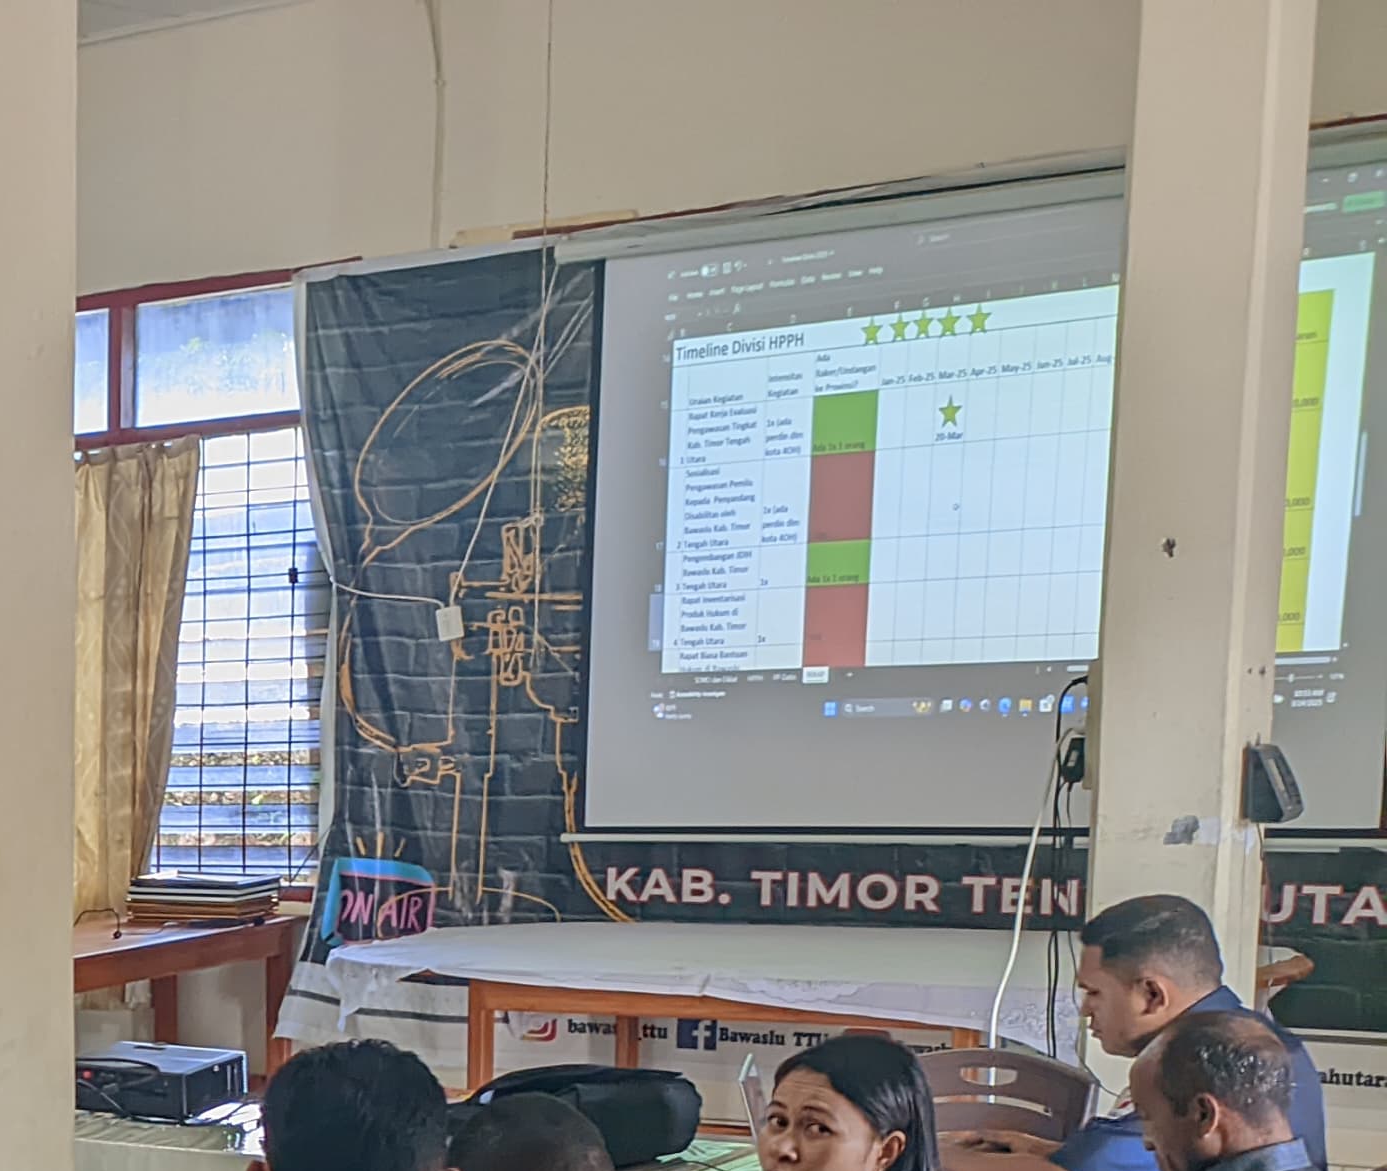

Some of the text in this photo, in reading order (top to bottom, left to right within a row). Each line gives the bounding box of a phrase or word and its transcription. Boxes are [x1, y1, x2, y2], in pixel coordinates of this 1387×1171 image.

[676, 343, 728, 361] Timeline
[732, 337, 765, 354] Divisi
[769, 333, 804, 348] HPPH
[605, 866, 731, 905] KAB.
[751, 870, 940, 914] TIMOR
[381, 896, 422, 932] AIR
[719, 1028, 784, 1046] Bawaslu
